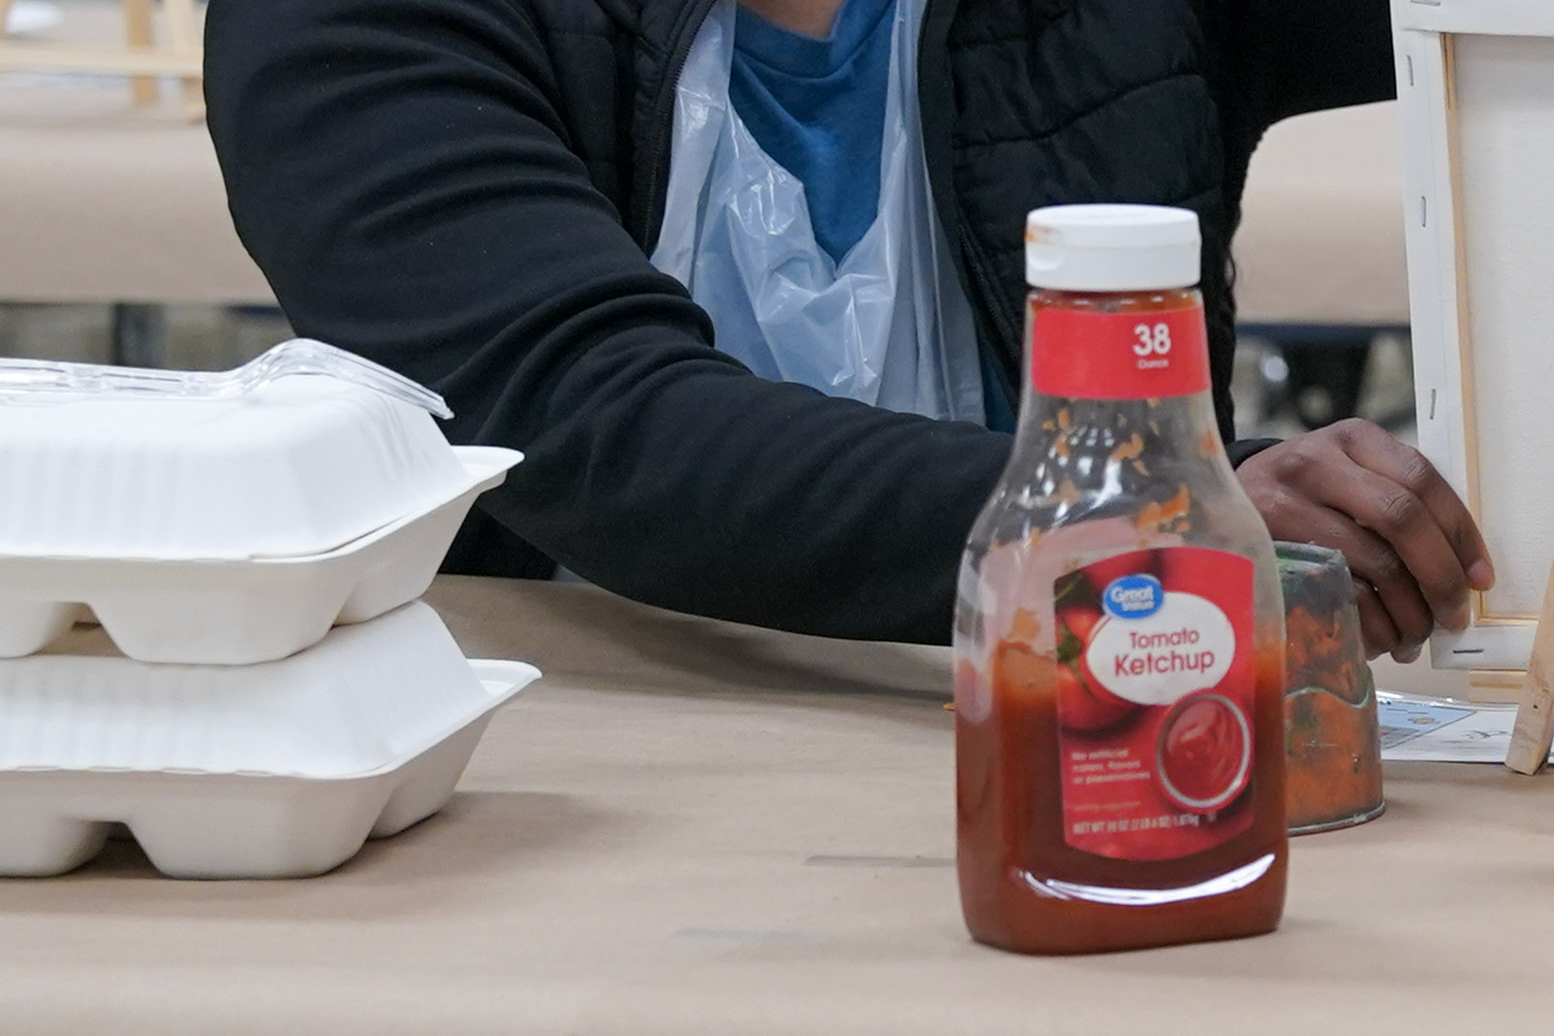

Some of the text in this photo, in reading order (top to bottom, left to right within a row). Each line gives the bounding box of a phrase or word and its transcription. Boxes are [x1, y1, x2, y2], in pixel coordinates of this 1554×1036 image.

[1133, 323, 1171, 356] 38
[1111, 585, 1154, 603] Great
[1129, 628, 1200, 649] Tomato
[1114, 651, 1215, 677] Ketchup
